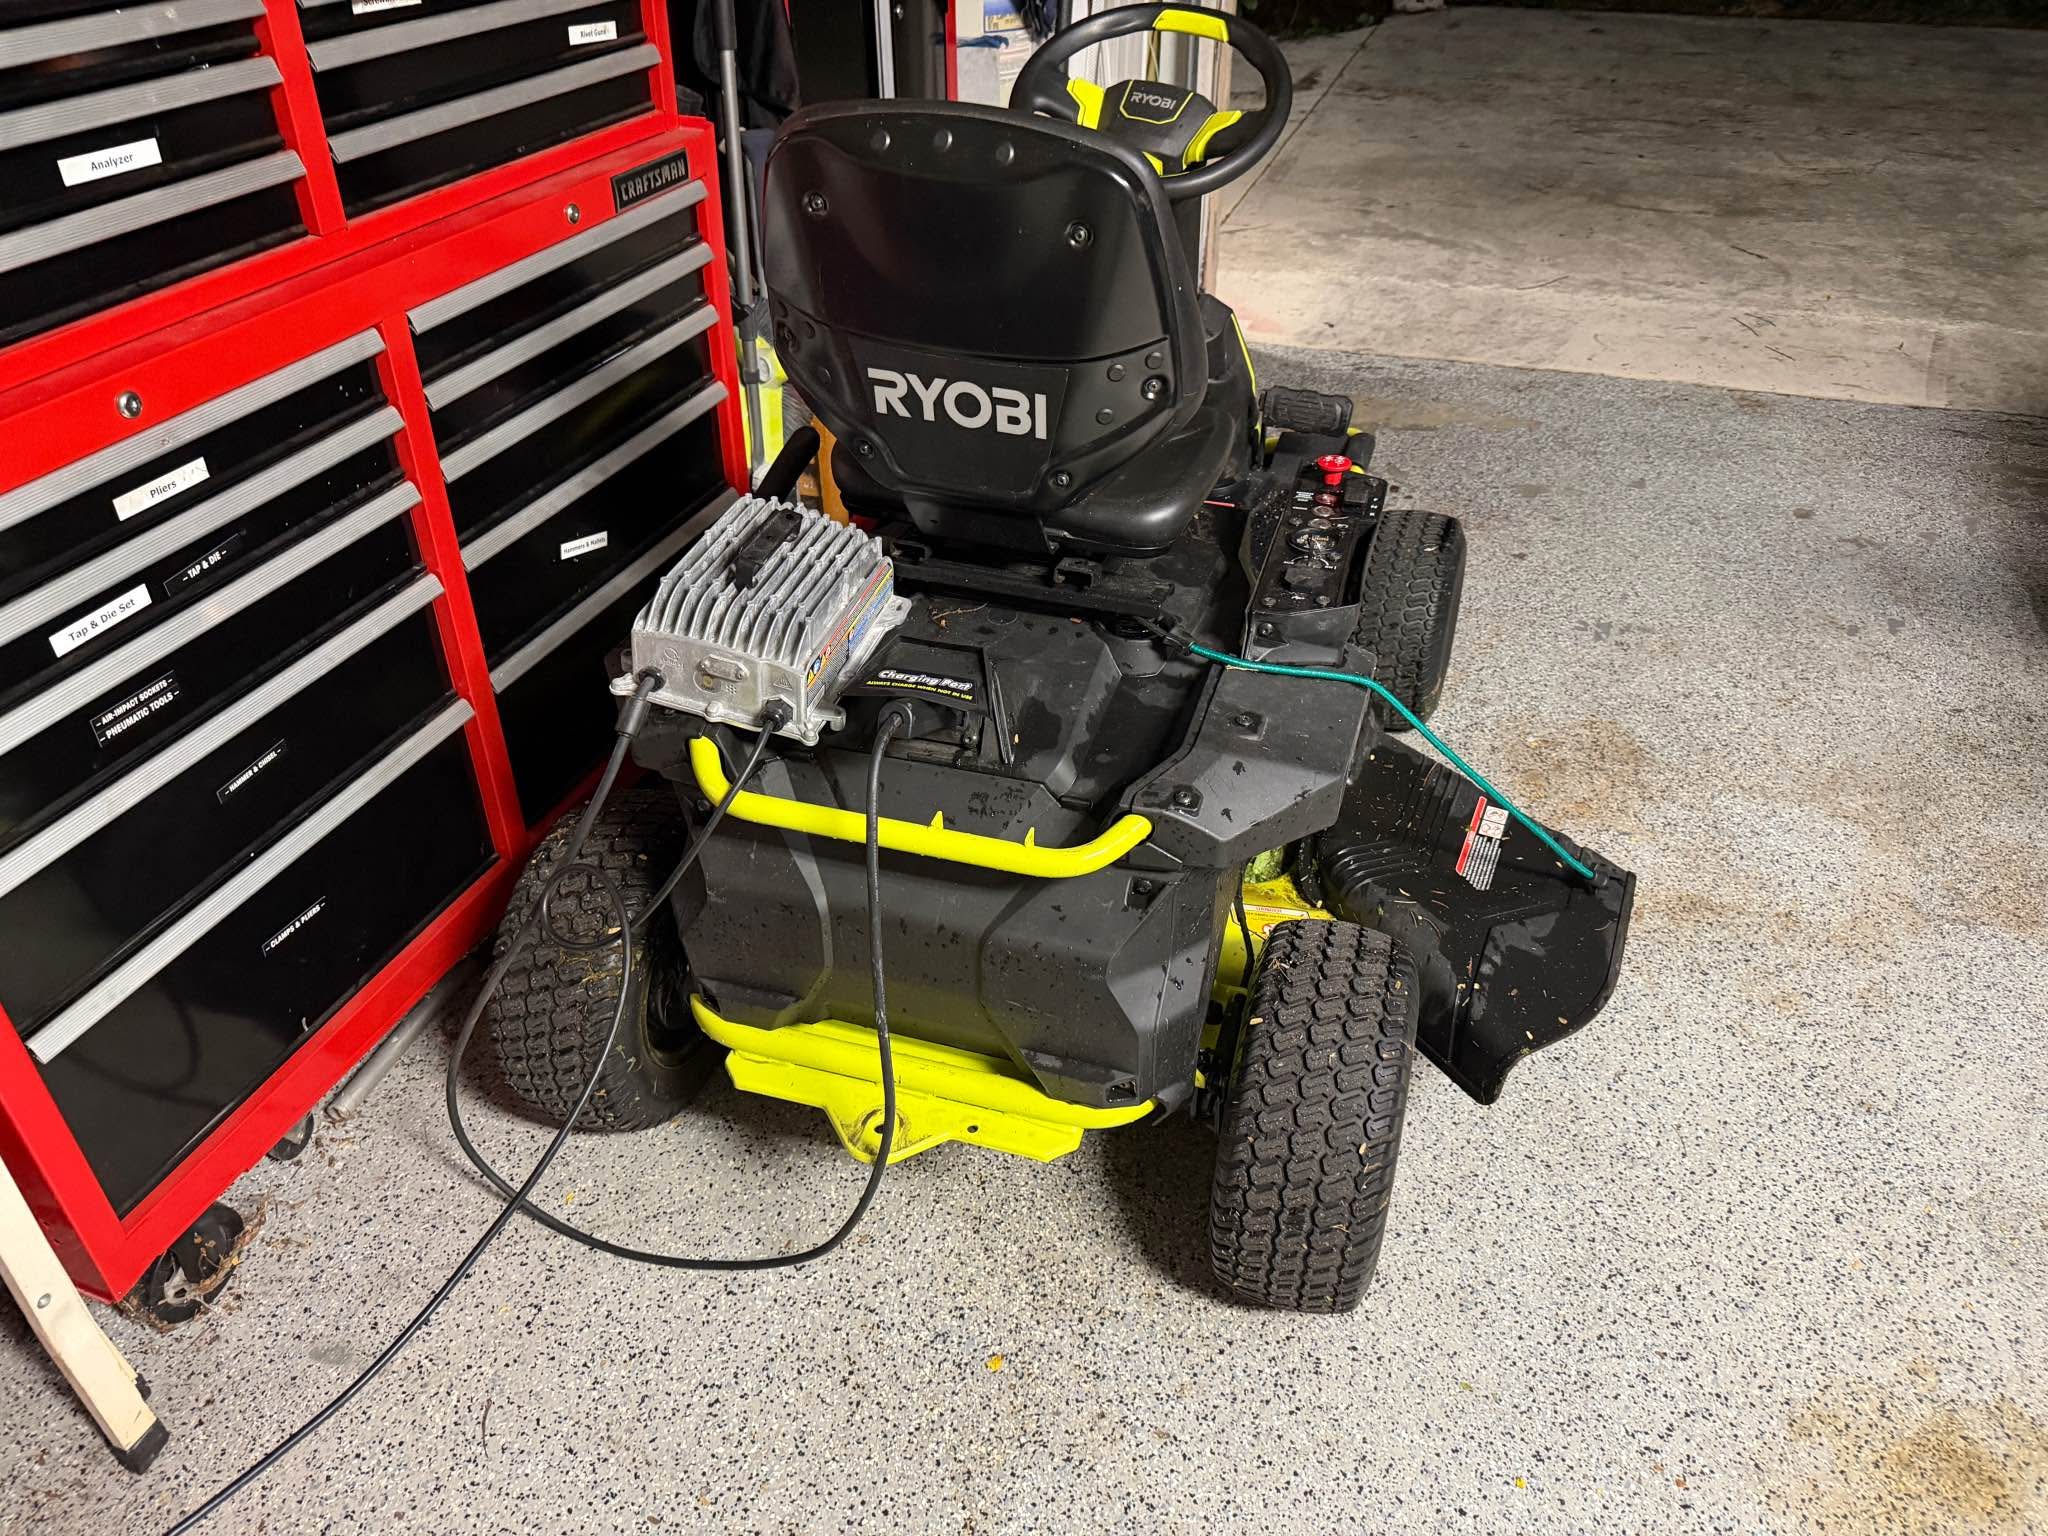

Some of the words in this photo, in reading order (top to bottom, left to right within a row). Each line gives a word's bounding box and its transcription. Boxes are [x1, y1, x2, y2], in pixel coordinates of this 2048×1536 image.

[1130, 91, 1176, 110] RYOBI
[90, 153, 134, 171] Analyzer
[620, 159, 686, 201] CRAFTSMAN
[867, 367, 1048, 440] RYOBI
[150, 480, 177, 498] Pliers
[187, 564, 201, 579] TAP
[201, 560, 209, 570] &
[208, 551, 221, 565] DIE
[68, 626, 89, 641] Tap
[90, 620, 98, 630] &
[100, 609, 117, 624] Die
[118, 598, 136, 613] Set
[879, 669, 942, 686] Charging
[941, 677, 973, 691] Port
[101, 696, 140, 725] AIR-IMPACT
[139, 679, 168, 702] SOCKETS
[105, 707, 150, 739] PNEUMATIC
[149, 691, 174, 712] TOOLS
[229, 769, 254, 793] HAMMER
[252, 765, 259, 774] &
[258, 750, 278, 769] CHISEL
[270, 924, 295, 948] CLAMPS
[294, 920, 301, 929] &
[300, 904, 321, 924] PLIERS
